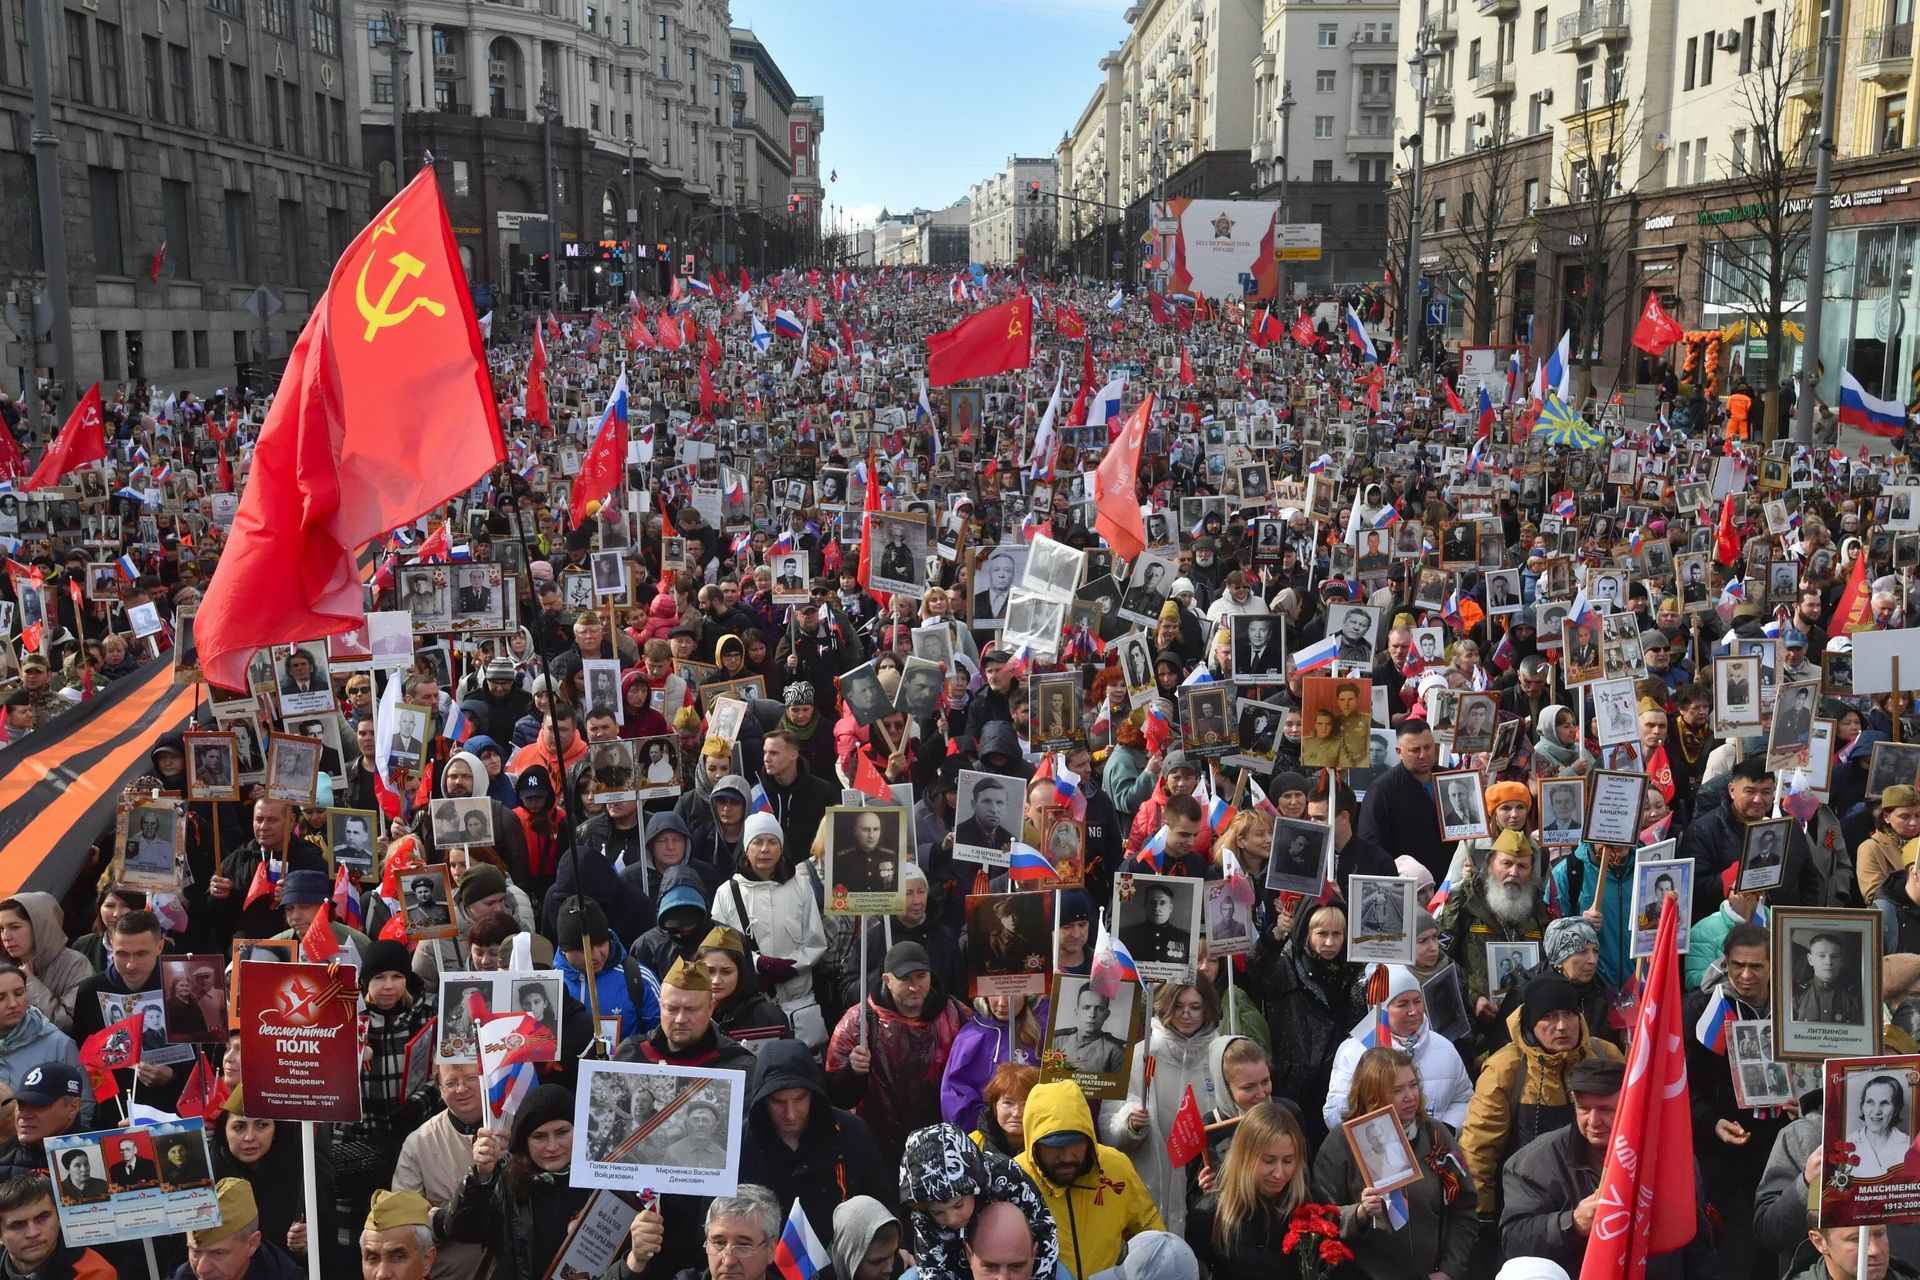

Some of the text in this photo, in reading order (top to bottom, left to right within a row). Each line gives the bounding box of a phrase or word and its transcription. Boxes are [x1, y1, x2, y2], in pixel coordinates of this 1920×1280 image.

[971, 849, 1002, 858] СМИРНОВ
[276, 1039, 320, 1054] ПОЛК
[278, 1059, 319, 1067] Болдырев
[275, 1076, 325, 1085] Болдыревич
[610, 1163, 638, 1172] Николай
[656, 1167, 692, 1175] Мироненко
[594, 1170, 634, 1180] Войцехович
[669, 1176, 704, 1184] Денисович
[598, 1211, 622, 1231] ФИЛАТОВ
